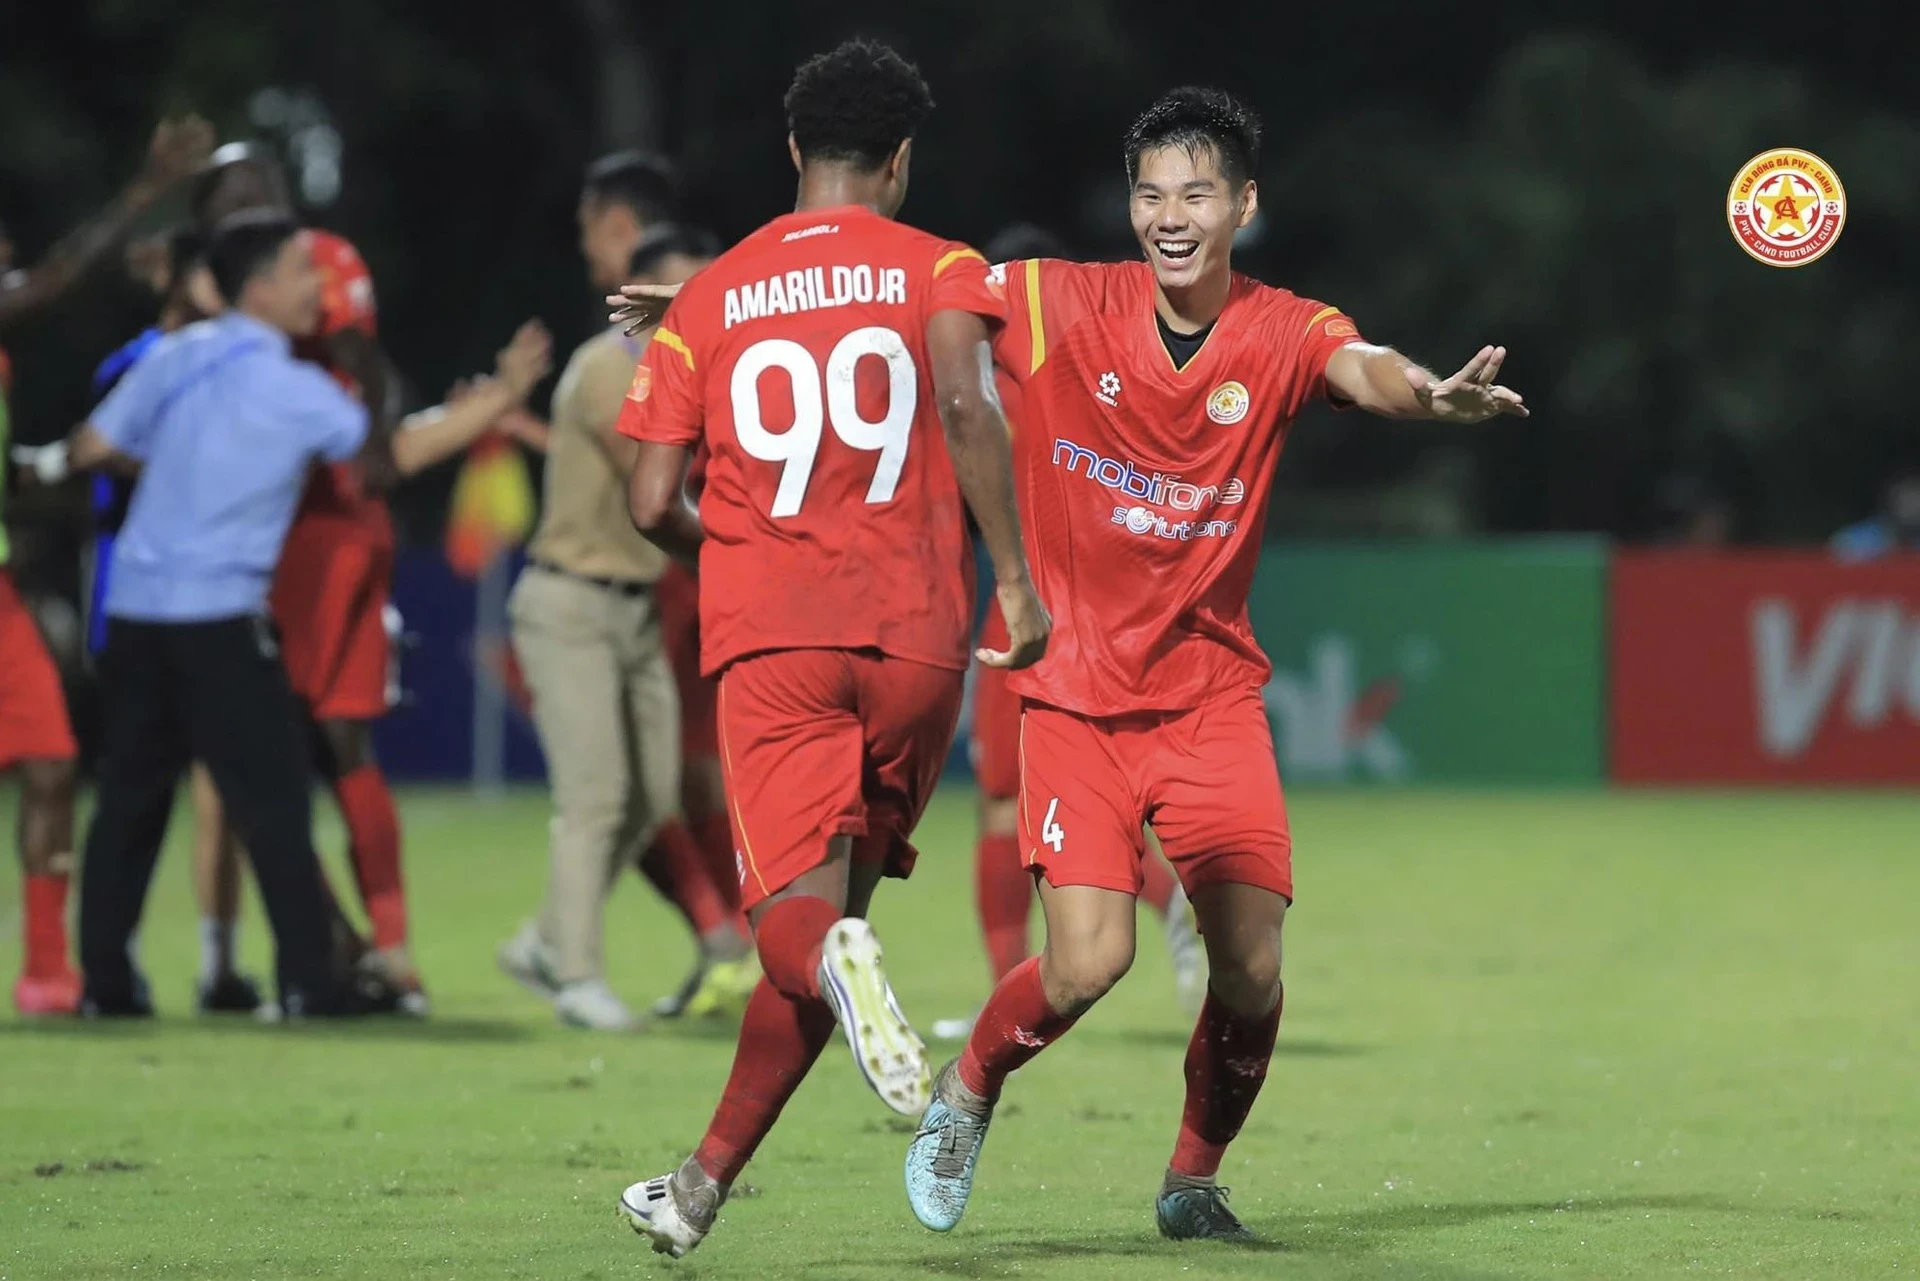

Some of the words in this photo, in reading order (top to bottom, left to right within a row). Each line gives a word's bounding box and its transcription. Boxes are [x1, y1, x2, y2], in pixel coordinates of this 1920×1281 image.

[724, 264, 874, 330] AMARILDO
[876, 267, 906, 304] JR
[730, 326, 918, 518] 99
[1052, 438, 1245, 511] mobifone
[1042, 797, 1065, 853] 4
